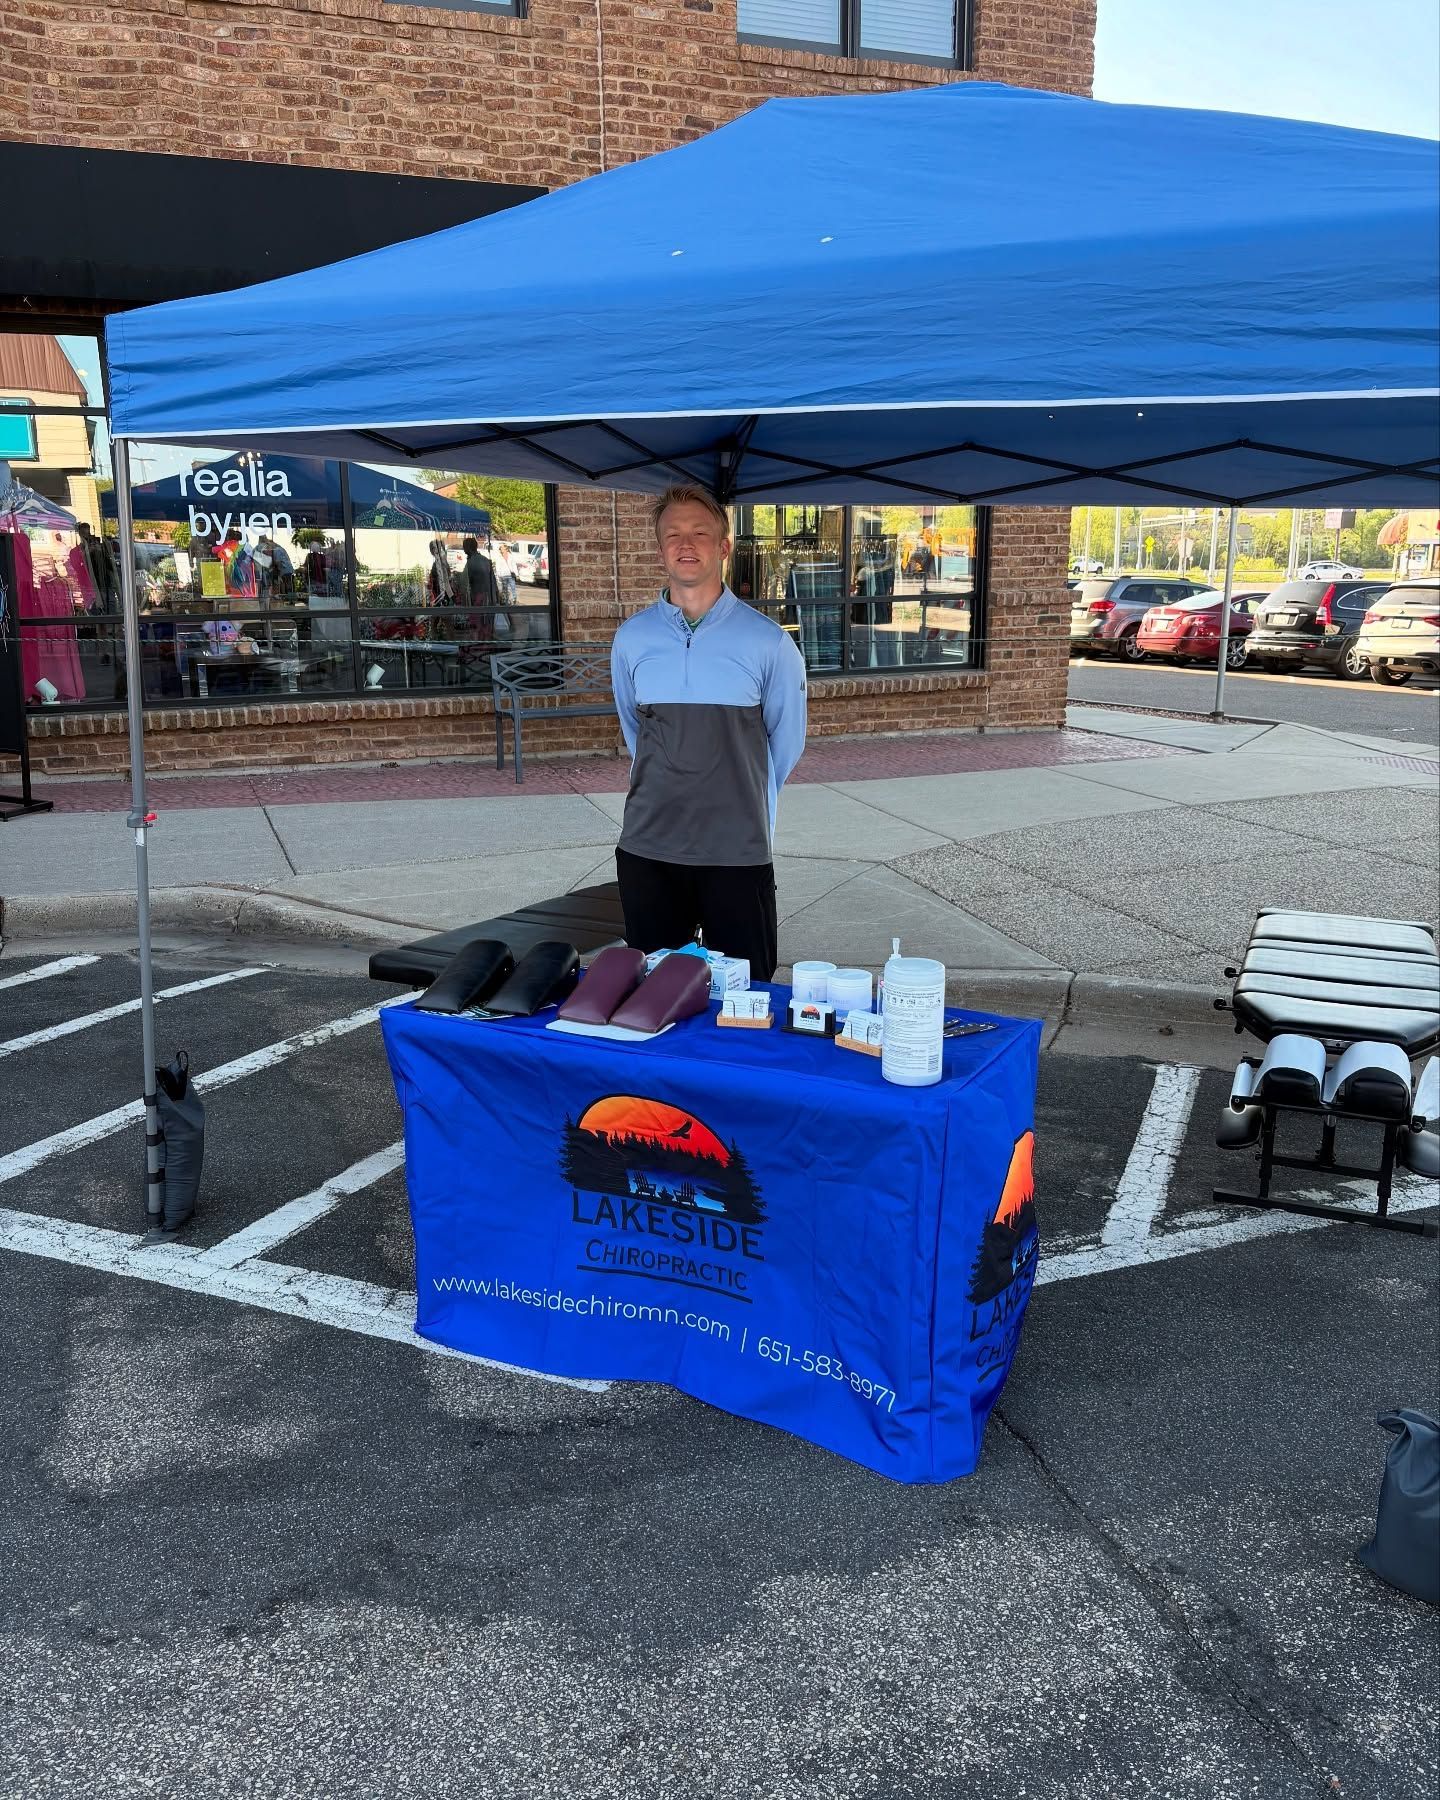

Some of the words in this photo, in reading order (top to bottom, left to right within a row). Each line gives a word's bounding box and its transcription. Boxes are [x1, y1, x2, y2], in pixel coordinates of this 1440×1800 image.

[178, 461, 292, 497] realia
[187, 504, 233, 546] by
[238, 512, 293, 546] jen
[571, 1191, 767, 1262] LAKESIDE
[584, 1238, 748, 1291] CHIROPRACTIC
[432, 1276, 731, 1342] www.lakesidechiromn.com
[757, 1335, 898, 1414] 651-583-8971
